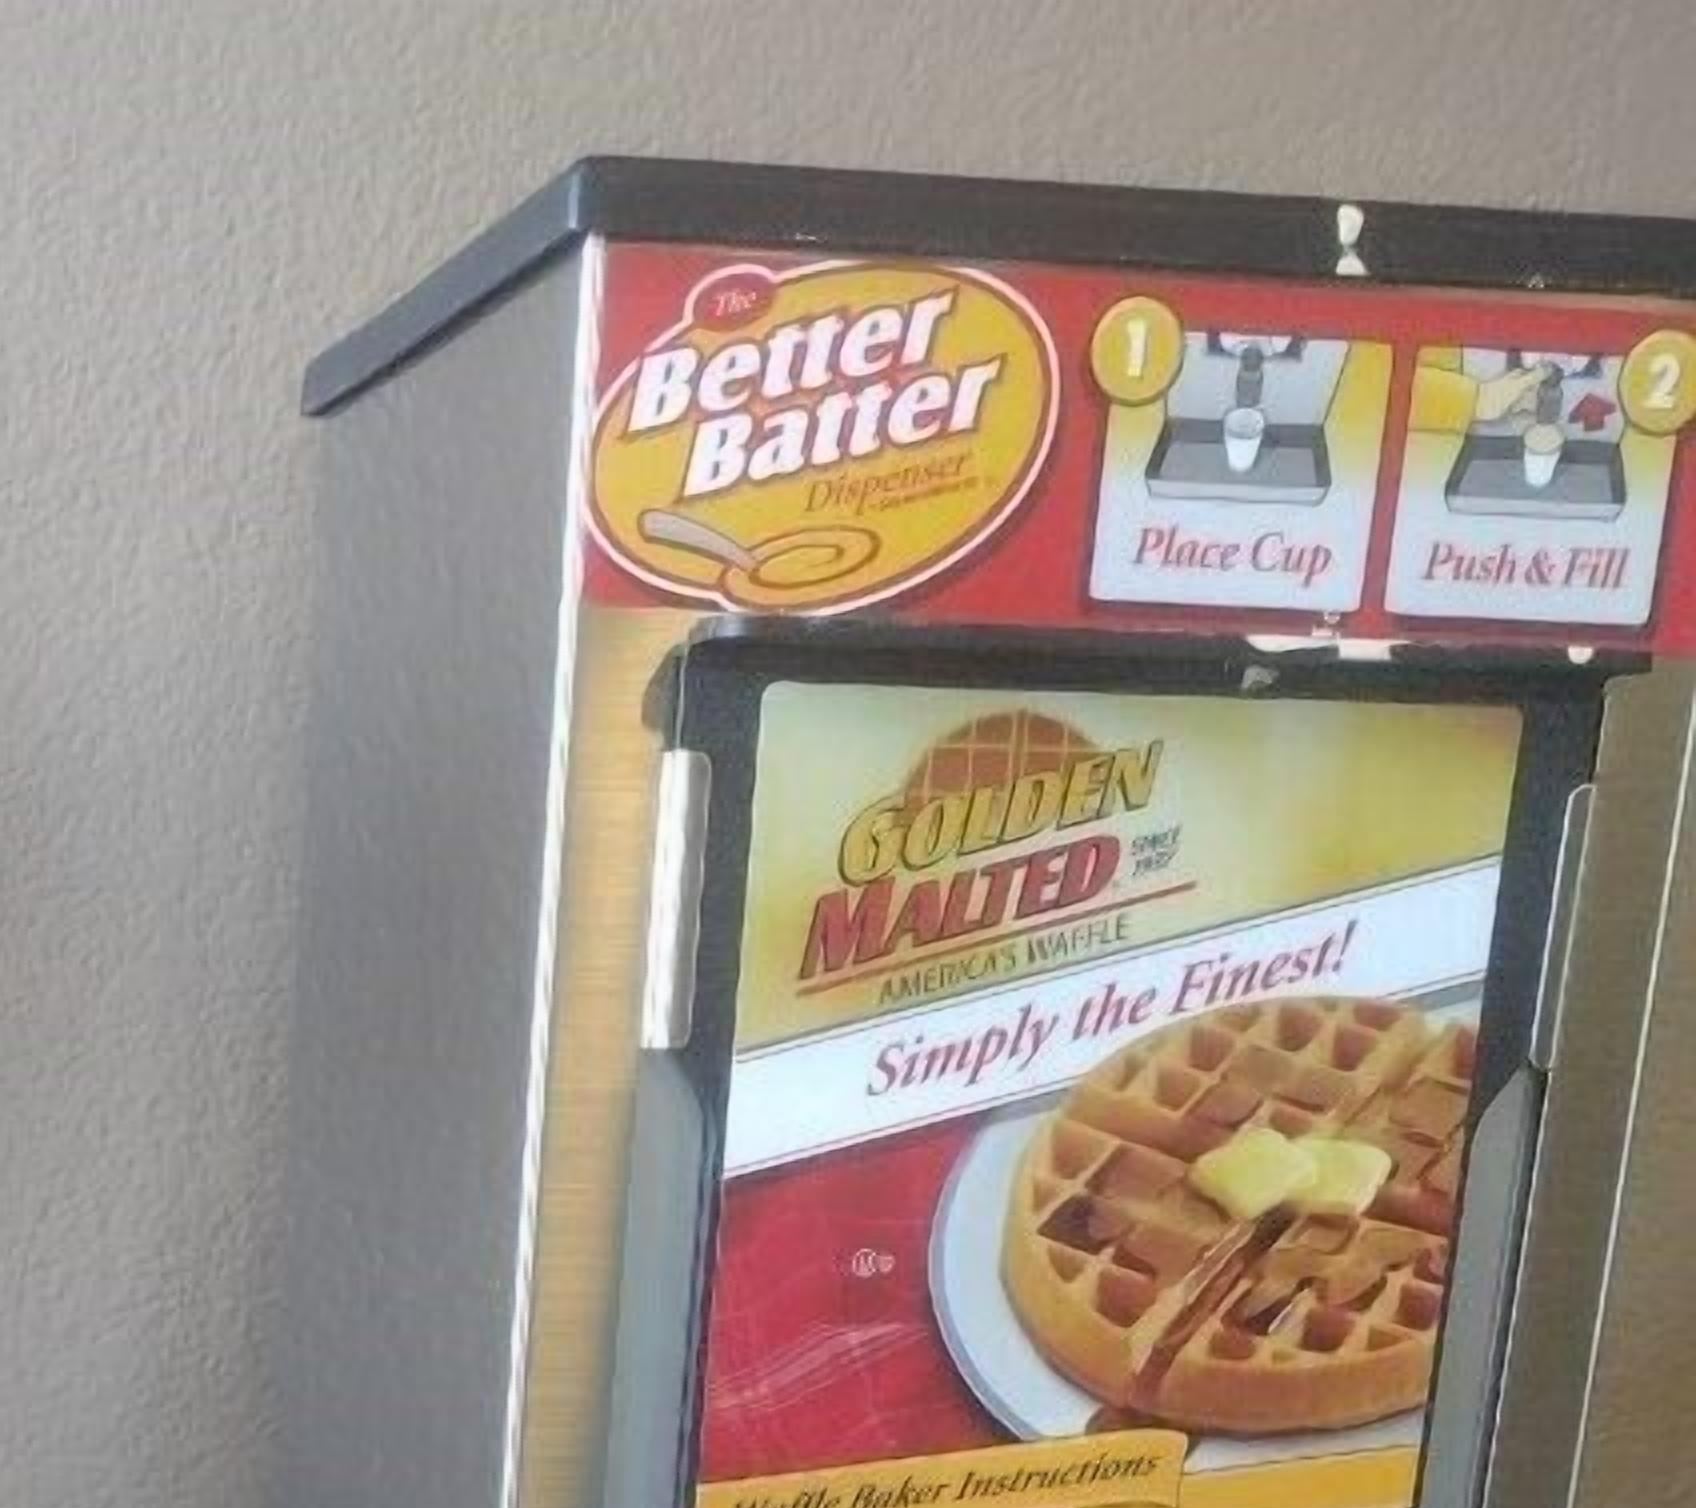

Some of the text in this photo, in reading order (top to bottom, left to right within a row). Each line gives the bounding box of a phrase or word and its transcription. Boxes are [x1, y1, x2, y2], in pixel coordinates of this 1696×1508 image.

[625, 287, 959, 437] Better
[1126, 318, 1147, 378] 1
[1645, 353, 1681, 410] 2
[683, 357, 1005, 499] Batter
[1133, 526, 1332, 582] Place Cup
[1422, 542, 1631, 590] Push & Fill
[837, 740, 1165, 887] GOLDEN
[800, 834, 1121, 980] MALTED
[878, 912, 1130, 1004] AMERICA'S WAFFLE
[867, 920, 1360, 1096] Simply the Finest!
[955, 1449, 1163, 1501] Instructions
